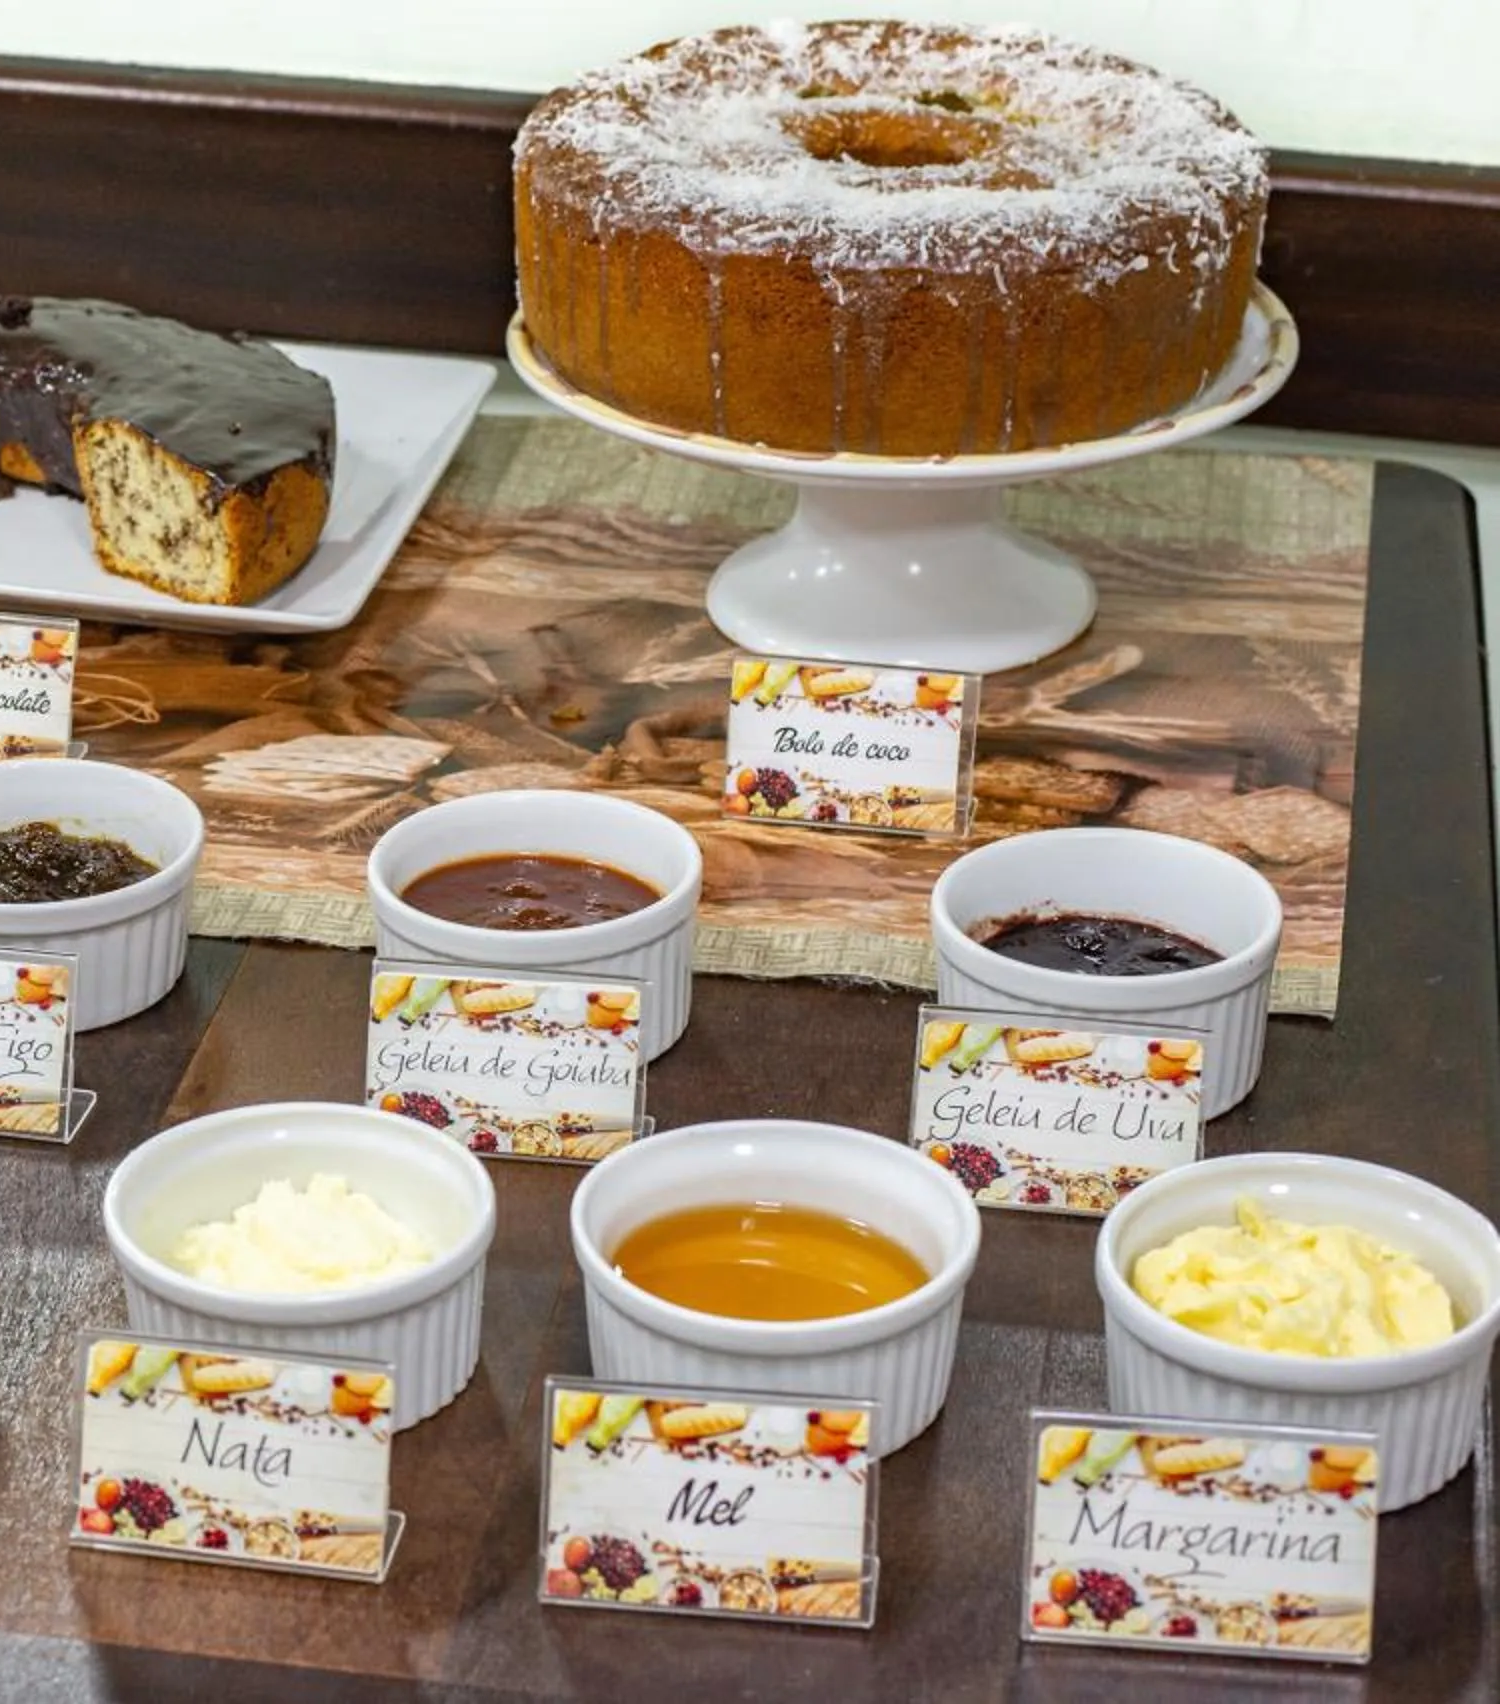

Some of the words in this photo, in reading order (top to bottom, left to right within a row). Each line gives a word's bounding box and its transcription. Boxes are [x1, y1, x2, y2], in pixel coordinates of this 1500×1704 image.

[774, 728, 827, 756] Bolo
[831, 735, 859, 758] de
[865, 742, 910, 762] coco
[375, 1040, 471, 1092] Geleia
[479, 1046, 515, 1076] de
[526, 1045, 631, 1096] Goiaba
[930, 1086, 1043, 1143] Geleia
[1053, 1093, 1096, 1134] de
[1112, 1101, 1185, 1143] Uva
[180, 1418, 293, 1488] Nata
[666, 1479, 755, 1528] Mel
[1068, 1496, 1341, 1579] Margarina
